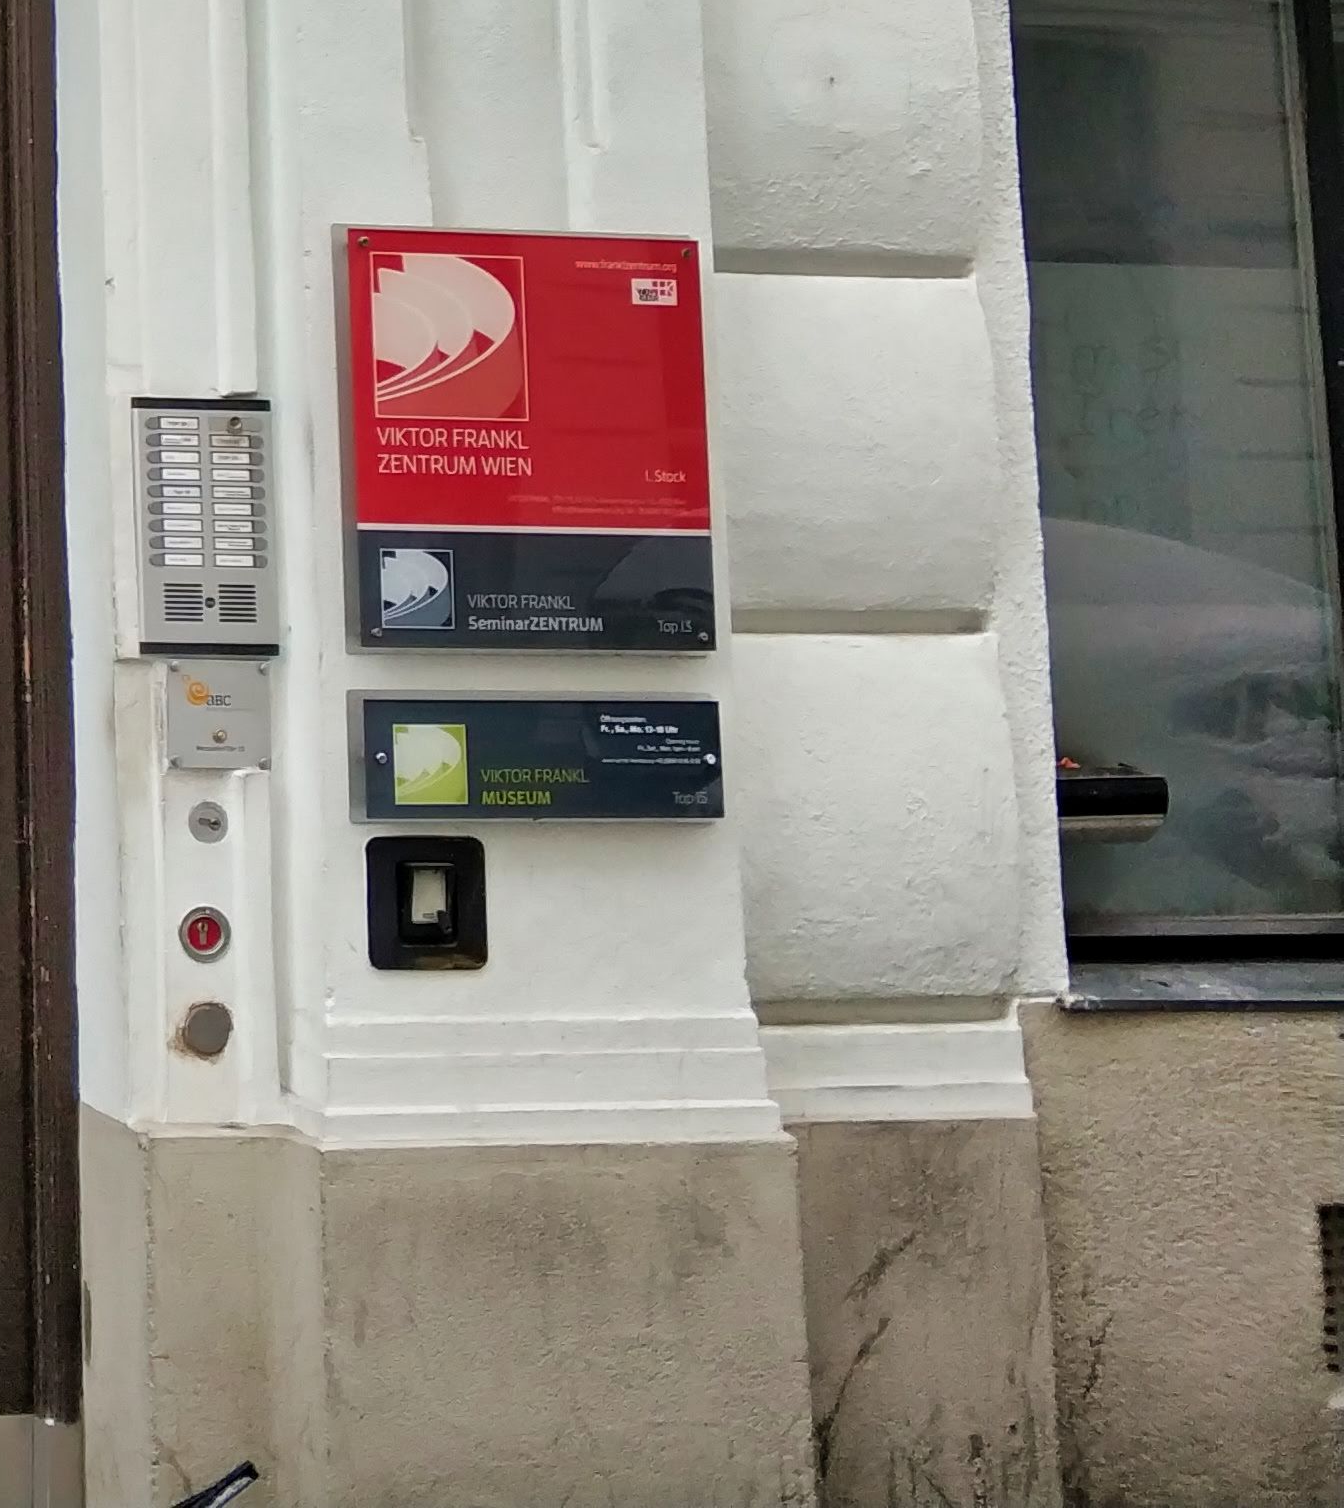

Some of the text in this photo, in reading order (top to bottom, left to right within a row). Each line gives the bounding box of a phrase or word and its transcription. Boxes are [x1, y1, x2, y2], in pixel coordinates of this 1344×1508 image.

[376, 426, 530, 450] VIKTOR FRANKL
[377, 453, 533, 477] ZENTRUM WIEN
[654, 469, 687, 483] Stock
[468, 594, 575, 610] VIKTOR FRANKL
[468, 615, 604, 632] SeminarZENTRUM
[657, 619, 679, 634] Top
[481, 768, 590, 784] VIKTOR FRANKL
[481, 791, 552, 805] MUSEUM
